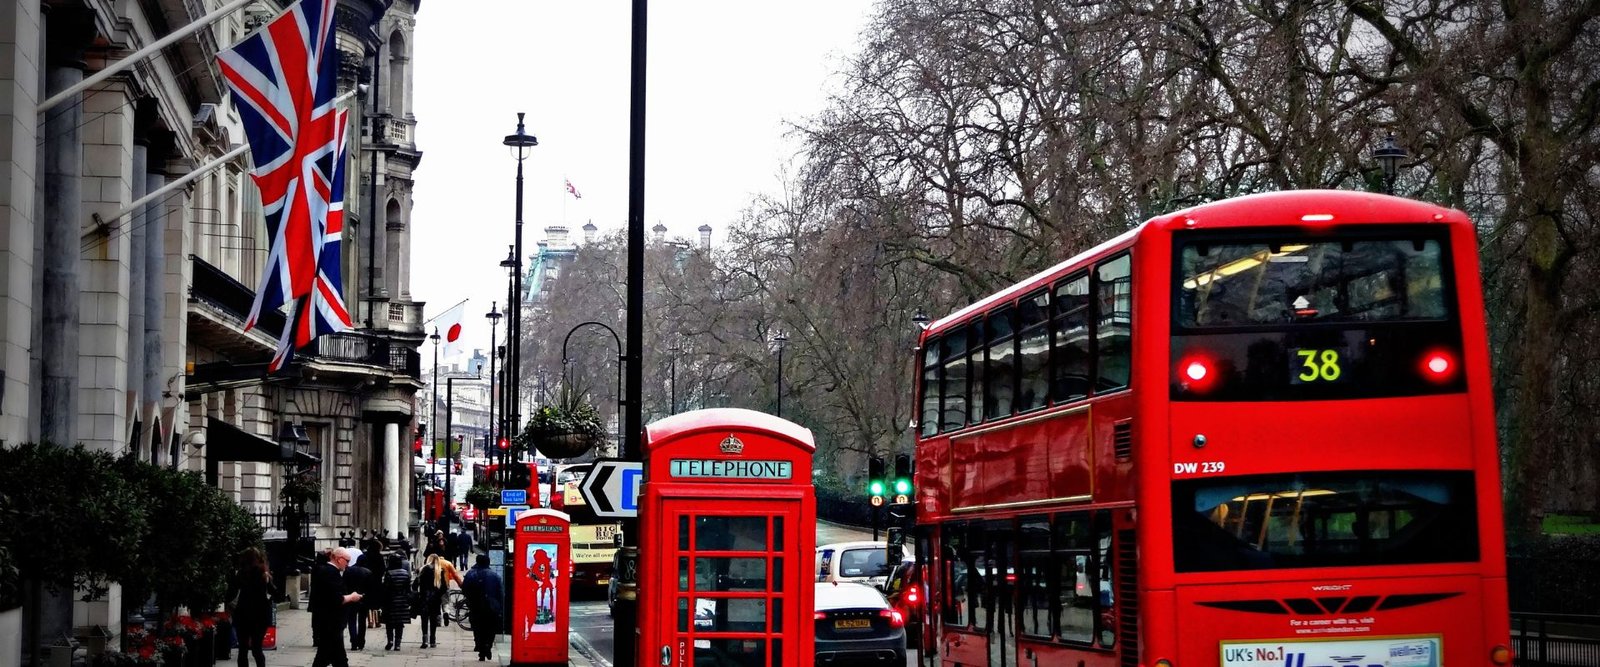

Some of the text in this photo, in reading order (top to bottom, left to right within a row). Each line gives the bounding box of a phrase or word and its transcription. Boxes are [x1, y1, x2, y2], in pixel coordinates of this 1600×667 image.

[1297, 349, 1341, 382] 38
[674, 460, 788, 478] TELEPHONE
[1174, 462, 1225, 474] DW 239
[1225, 648, 1253, 662] UK's
[1256, 646, 1284, 661] No.1
